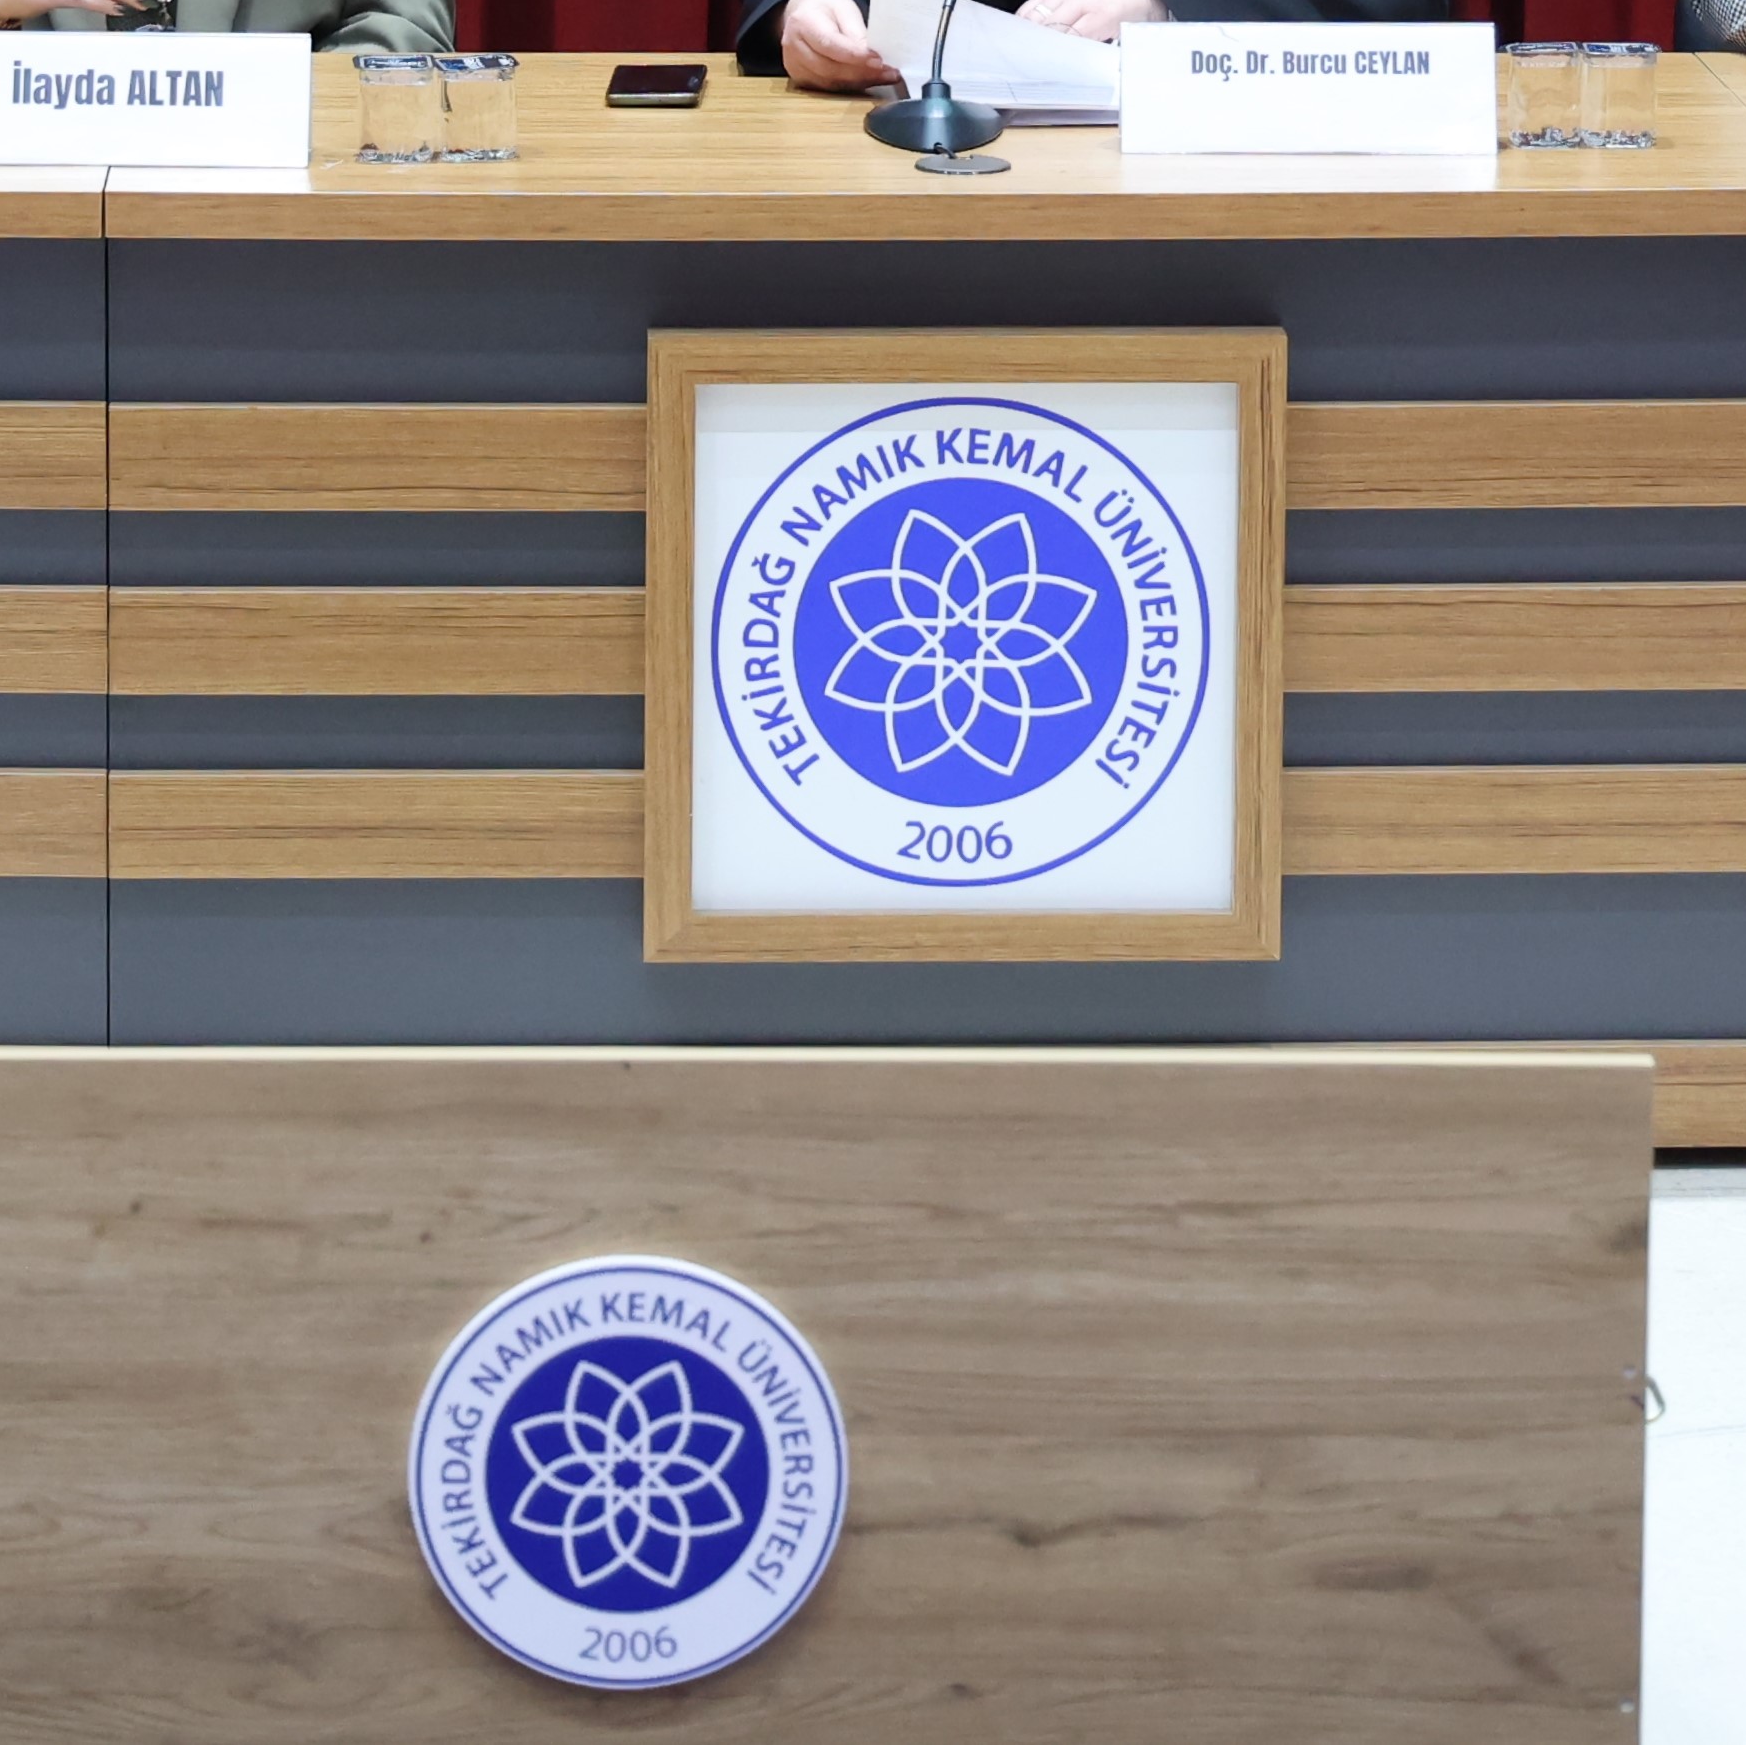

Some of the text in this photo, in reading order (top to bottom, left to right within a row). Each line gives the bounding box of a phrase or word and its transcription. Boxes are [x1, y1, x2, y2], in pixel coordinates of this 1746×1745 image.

[12, 60, 224, 109] İlayda ALTAN
[1191, 50, 1430, 82] Doç. Dr. Burcu CEYLAN
[742, 427, 1181, 790] TEKİRDAĞ NAMIK KEMAL ÜNİVERSİTESİ
[896, 821, 1013, 864] 2006
[441, 1291, 817, 1600] TEKİRDAĞ NAMIK KEMAL ÜNİVERSİTESİ
[577, 1625, 679, 1663] 2006
